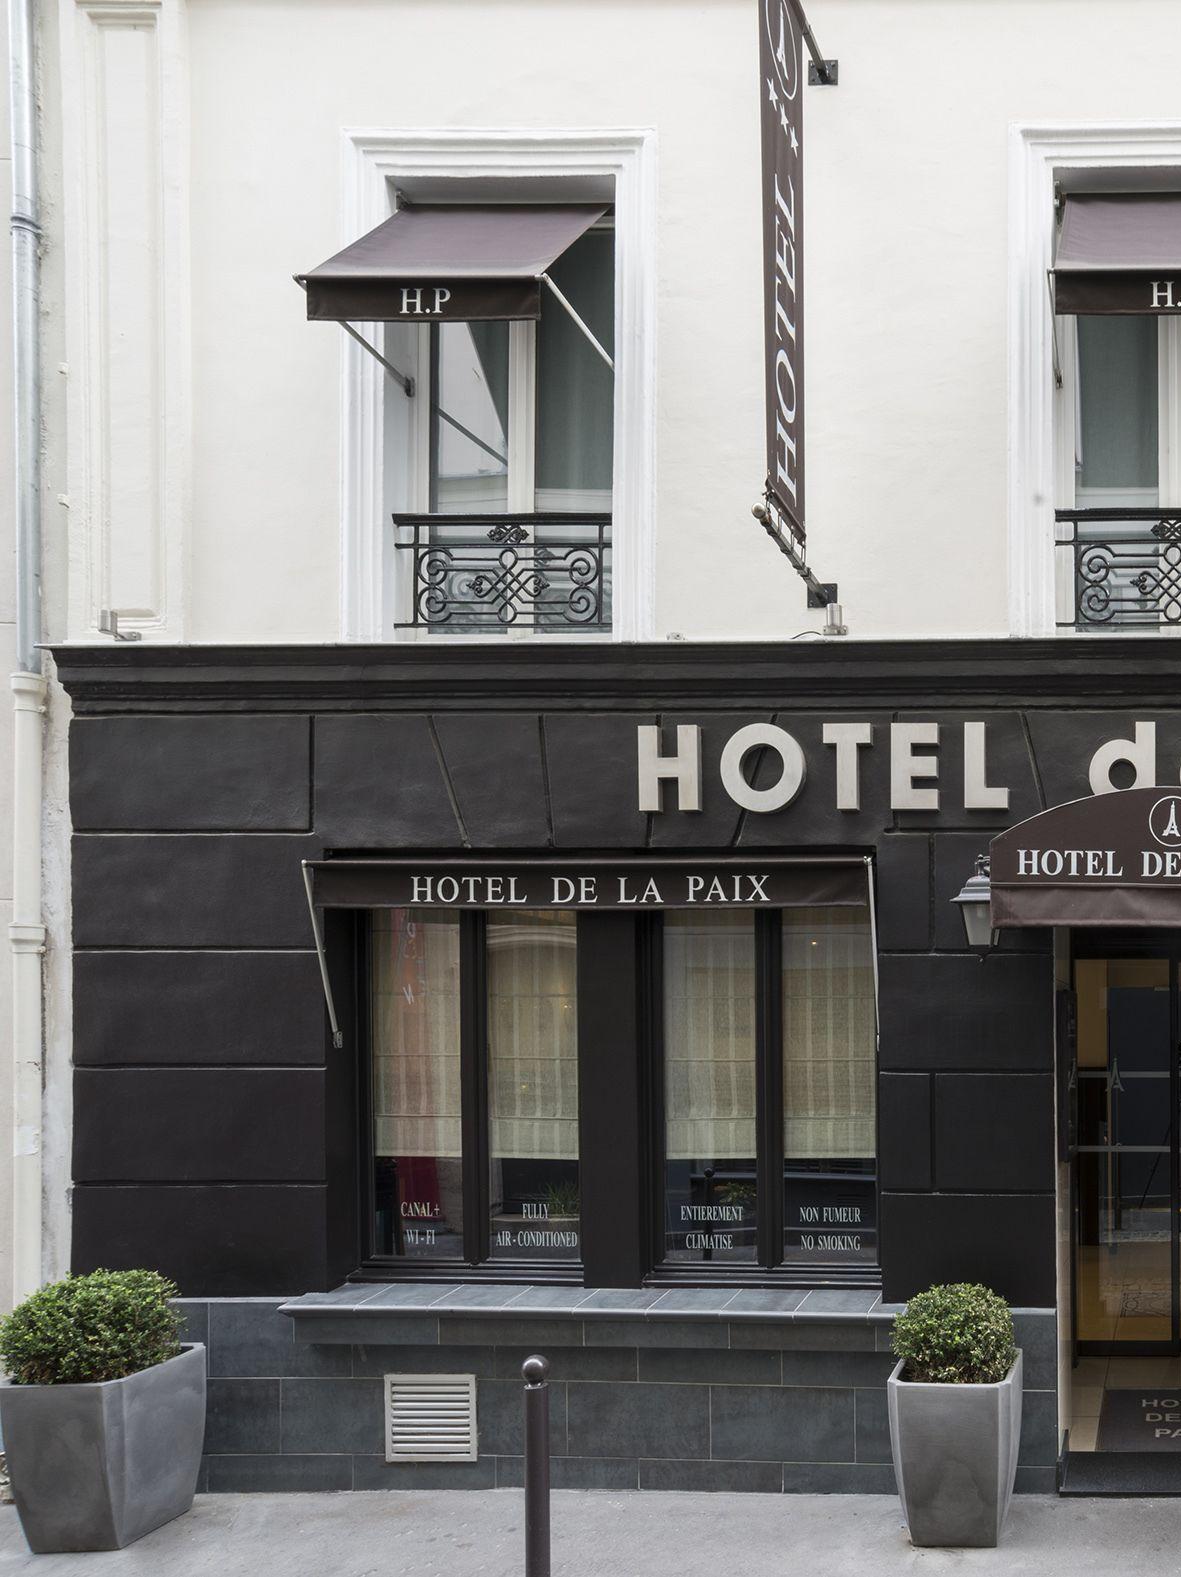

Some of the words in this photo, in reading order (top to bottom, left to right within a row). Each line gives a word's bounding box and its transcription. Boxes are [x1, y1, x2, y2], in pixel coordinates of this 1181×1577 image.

[400, 288, 451, 313] H.P
[774, 173, 798, 508] HOTEL
[637, 721, 1009, 813] HOTEL
[1017, 849, 1123, 878] HOTEL
[1140, 851, 1181, 878] DE
[410, 876, 528, 904] HOTEL
[550, 877, 598, 904] DE
[617, 876, 664, 904] LA
[686, 874, 770, 903] PAIX
[522, 1203, 550, 1219] FULLY
[681, 1205, 743, 1221] ENTIEREMENT
[800, 1207, 819, 1222] NON
[823, 1207, 861, 1222] FUMEUR
[686, 1234, 733, 1249] CLIMATISE
[801, 1235, 814, 1250] NO
[818, 1235, 861, 1251] SMOKING
[1145, 1413, 1181, 1422] DE
